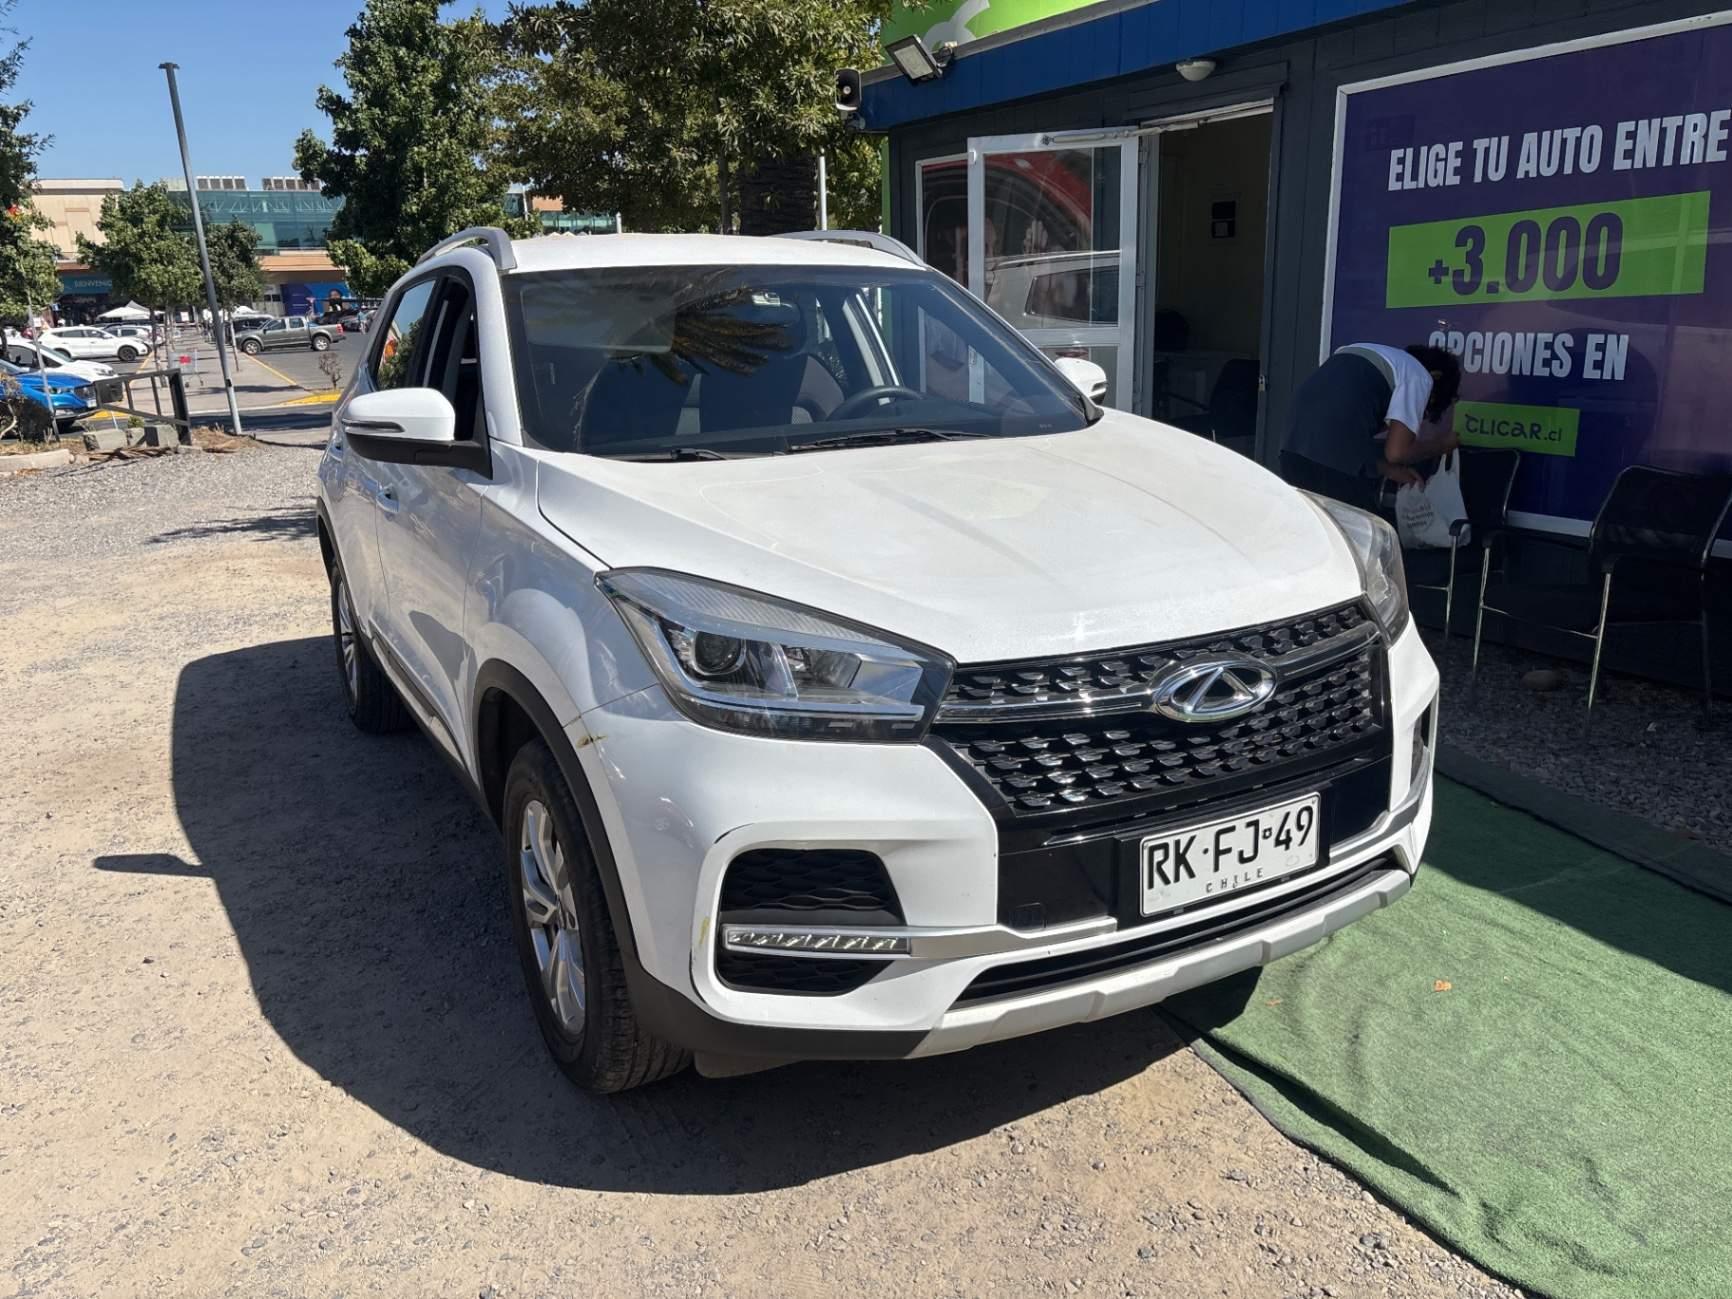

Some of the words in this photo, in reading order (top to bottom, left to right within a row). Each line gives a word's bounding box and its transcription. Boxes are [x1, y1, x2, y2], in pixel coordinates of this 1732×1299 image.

[1388, 141, 1463, 191] ELIGE
[1472, 136, 1509, 183] TU
[1516, 125, 1603, 179] AUTO
[1613, 109, 1731, 171] ENTRE
[1428, 212, 1623, 295] +3.000
[1582, 333, 1630, 381] EN
[1205, 867, 1264, 893] CHILE
